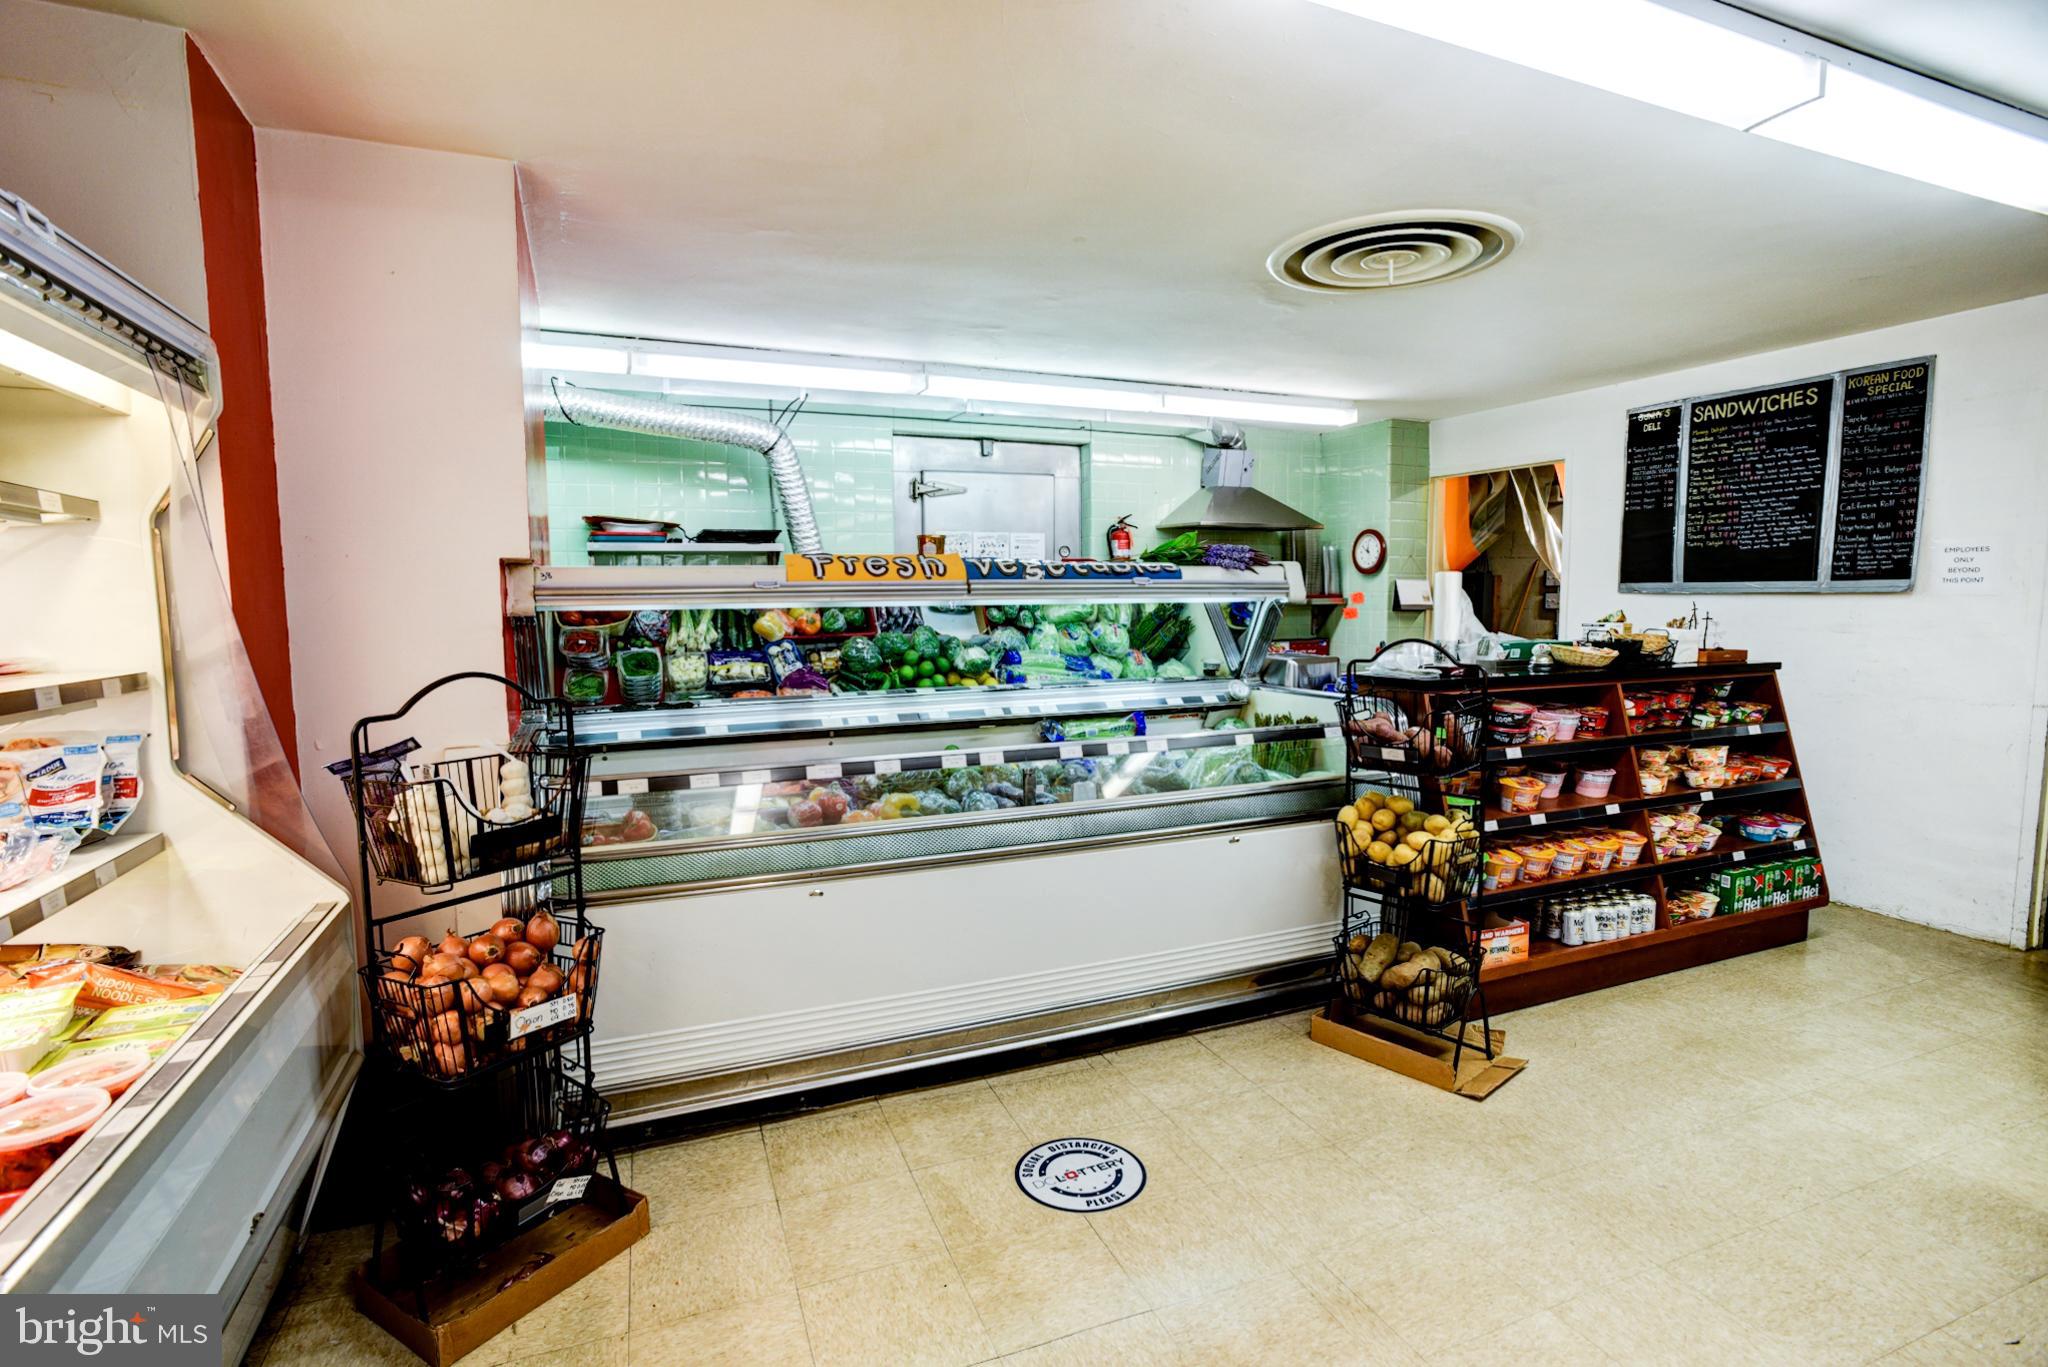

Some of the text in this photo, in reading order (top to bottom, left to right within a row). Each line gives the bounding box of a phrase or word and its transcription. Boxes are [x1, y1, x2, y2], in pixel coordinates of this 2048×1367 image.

[1848, 367, 1924, 389] KOREAN FOOD
[1867, 380, 1914, 396] SPECIAL
[1693, 387, 1818, 422] SANDWICHES
[1643, 422, 1661, 432] DELI
[806, 553, 946, 580] Fresh
[1495, 926, 1525, 937] WARMERS
[97, 976, 135, 992] UDON
[91, 987, 144, 1005] NOODLE
[515, 1014, 544, 1030] Onion
[1022, 1141, 1119, 1178] SOCIAL DISTANCING
[1055, 1157, 1125, 1183] LOTTERY
[1085, 1190, 1126, 1208] PLEASE
